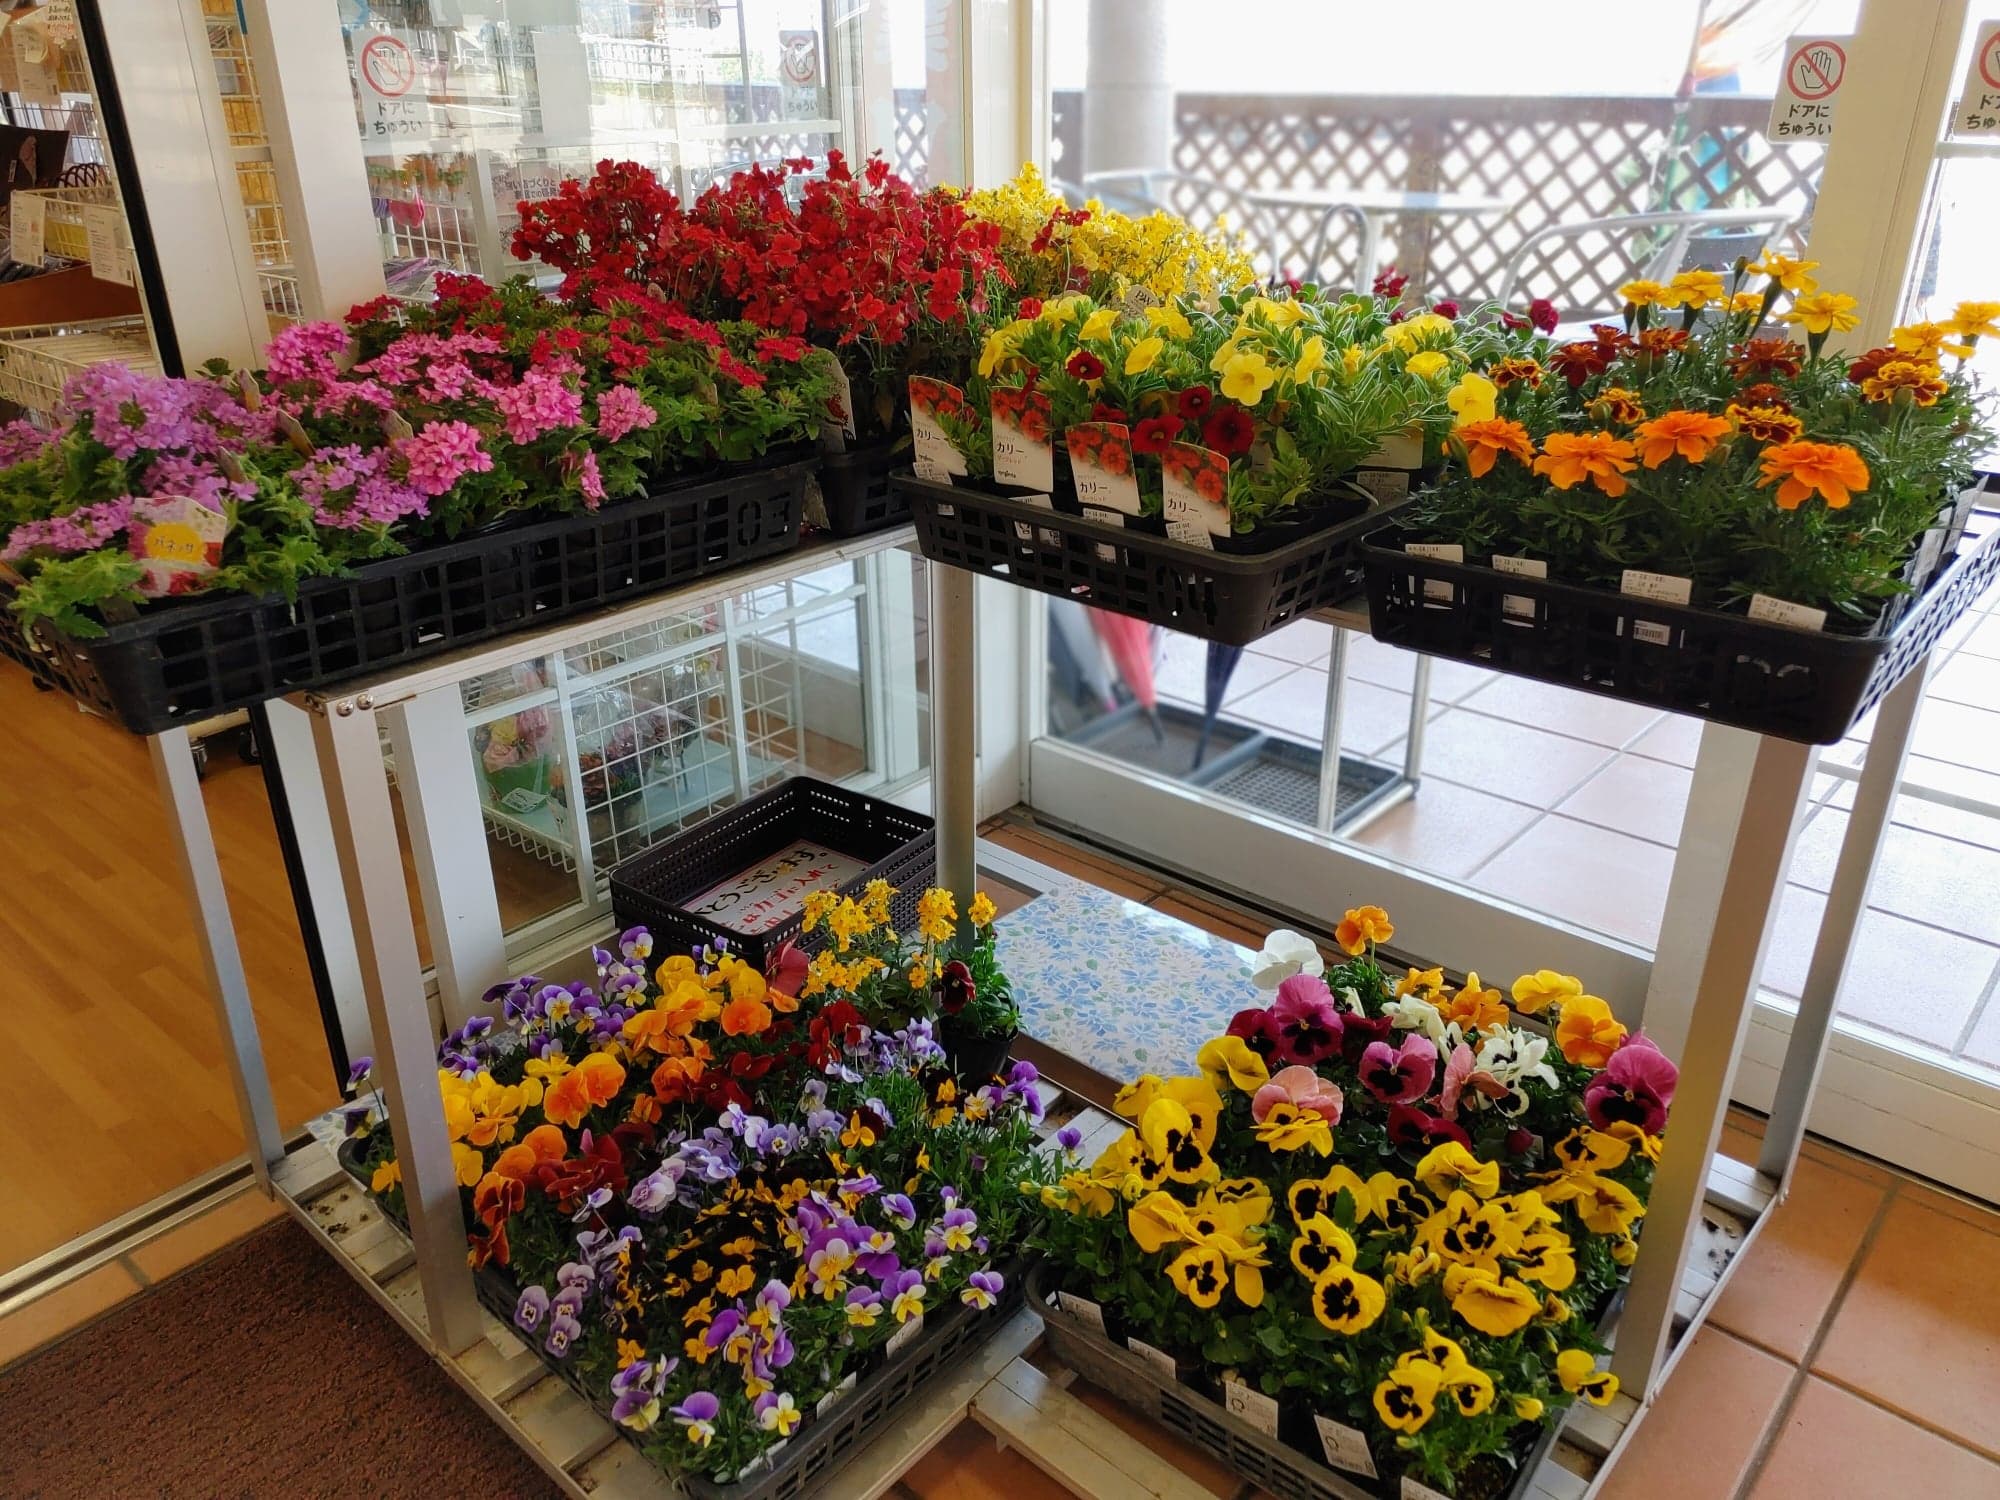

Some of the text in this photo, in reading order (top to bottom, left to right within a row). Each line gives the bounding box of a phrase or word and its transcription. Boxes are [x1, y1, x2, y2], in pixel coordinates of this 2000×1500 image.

[378, 100, 416, 116] ドアに
[1788, 104, 1830, 118] ドアに
[373, 119, 423, 135] ちゅうい
[1778, 122, 1832, 137] ちゅうい
[1966, 114, 2000, 130] ちゅ
[916, 427, 942, 441] カリー
[996, 441, 1026, 455] カリー
[1079, 481, 1109, 494] カリー
[1167, 497, 1200, 513] カリー
